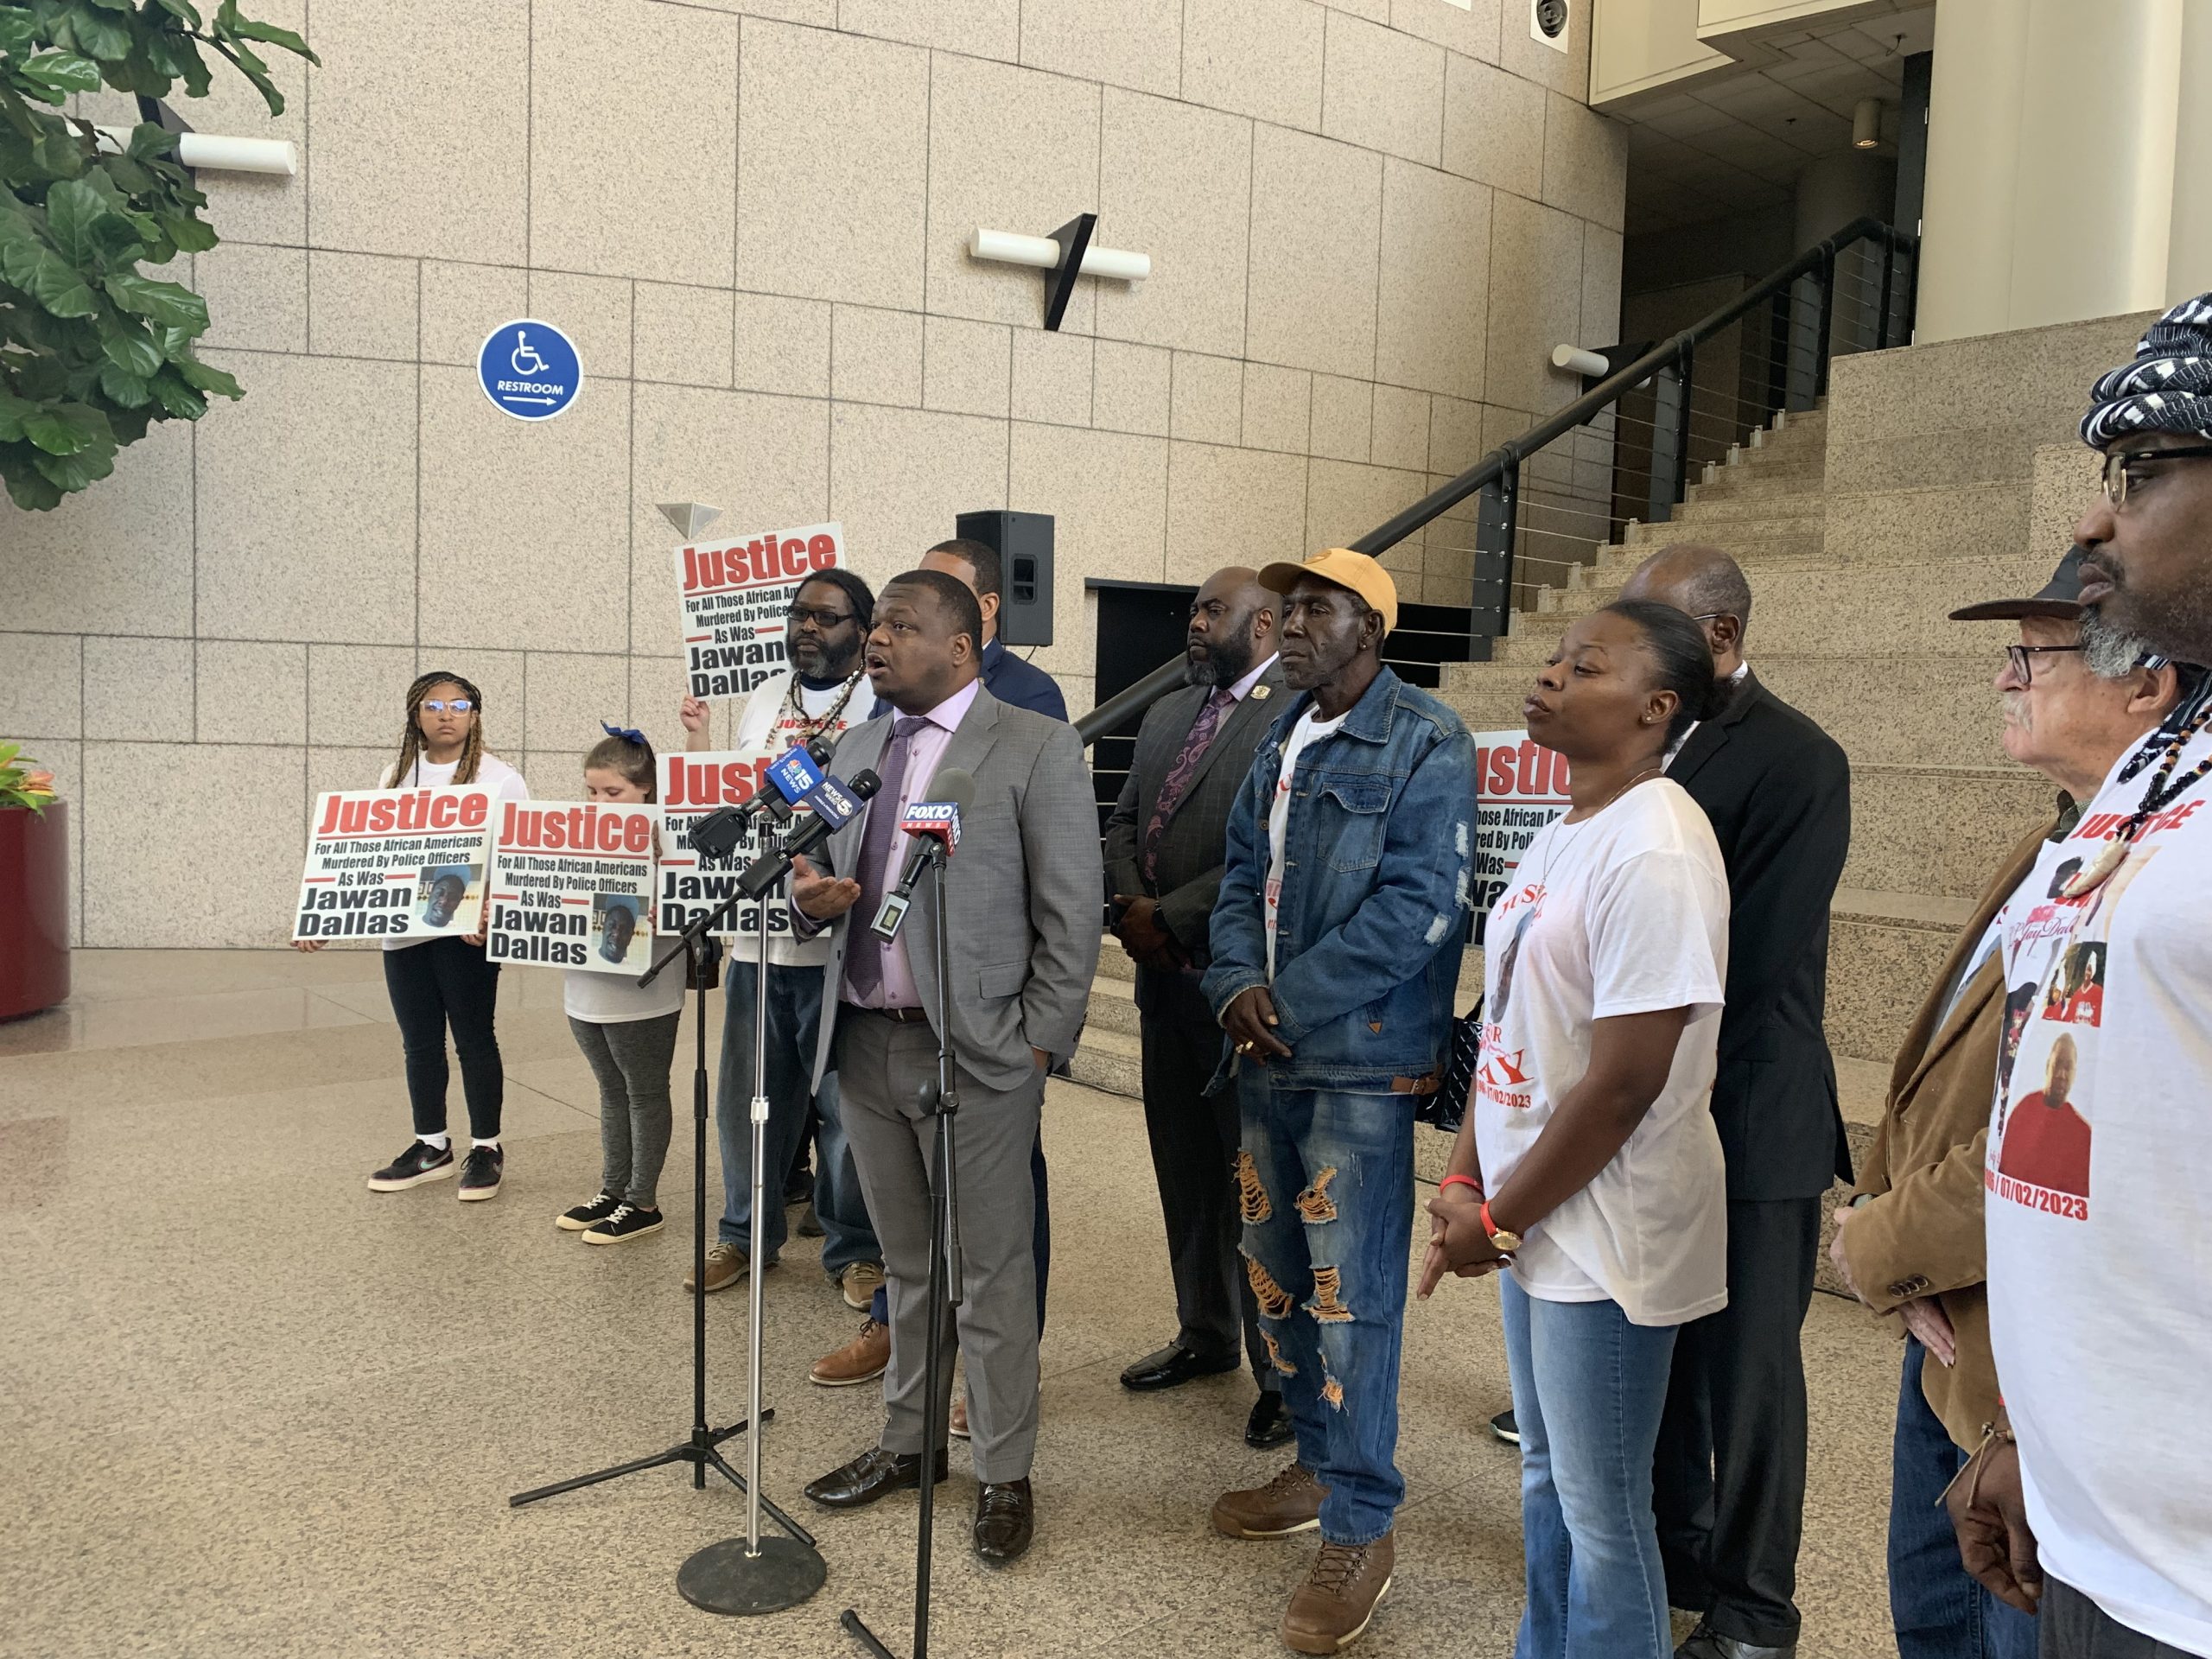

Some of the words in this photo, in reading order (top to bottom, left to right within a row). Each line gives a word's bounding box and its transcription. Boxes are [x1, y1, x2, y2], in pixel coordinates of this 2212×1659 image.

[497, 380, 563, 396] RESTROOM
[683, 533, 837, 591] Justice
[685, 600, 700, 613] For
[702, 597, 715, 611] All
[715, 594, 744, 608] Those
[746, 589, 782, 604] African
[696, 609, 742, 628] Murdered
[743, 608, 755, 622] By
[757, 605, 788, 620] Police
[715, 628, 728, 645] As
[729, 626, 755, 643] Was
[690, 640, 785, 671] Jawan
[664, 755, 778, 805] Just
[780, 768, 802, 794] NEWS
[794, 768, 814, 790] 15
[821, 782, 843, 800] NEWS
[838, 799, 852, 815] 5
[824, 793, 837, 805] WKRG
[317, 790, 488, 834] Justice
[906, 805, 953, 819] FOX10
[1477, 810, 1501, 825] hose
[1503, 809, 1545, 827] African
[499, 803, 650, 853] Justice
[665, 817, 682, 831] For
[315, 842, 331, 855] For
[333, 841, 347, 854] All
[350, 840, 381, 854] Those
[383, 838, 423, 852] African
[423, 836, 483, 850] Americans
[740, 835, 755, 850] By
[1496, 831, 1510, 851] By
[1511, 831, 1534, 850] Poli
[321, 855, 375, 870] Murdered
[376, 855, 389, 868] By
[391, 854, 424, 867] Police
[427, 851, 470, 865] Officers
[498, 855, 512, 869] For
[513, 856, 525, 870] All
[527, 857, 556, 871] Those
[557, 859, 592, 874] African
[594, 860, 647, 877] Americans
[698, 855, 716, 872] As
[719, 853, 752, 872] Was
[1477, 853, 1504, 875] Was
[338, 872, 353, 887] As
[356, 871, 385, 886] Was
[505, 873, 550, 889] Murdered
[552, 875, 564, 891] By
[566, 876, 596, 892] Police
[599, 878, 638, 894] Officers
[302, 887, 412, 911] Jawan
[520, 890, 534, 907] As
[536, 891, 562, 909] Was
[297, 911, 409, 937] Dallas
[492, 905, 588, 937] Jawan
[491, 932, 588, 965] Dallas
[2000, 1176, 2089, 1221] 07/02/2023
